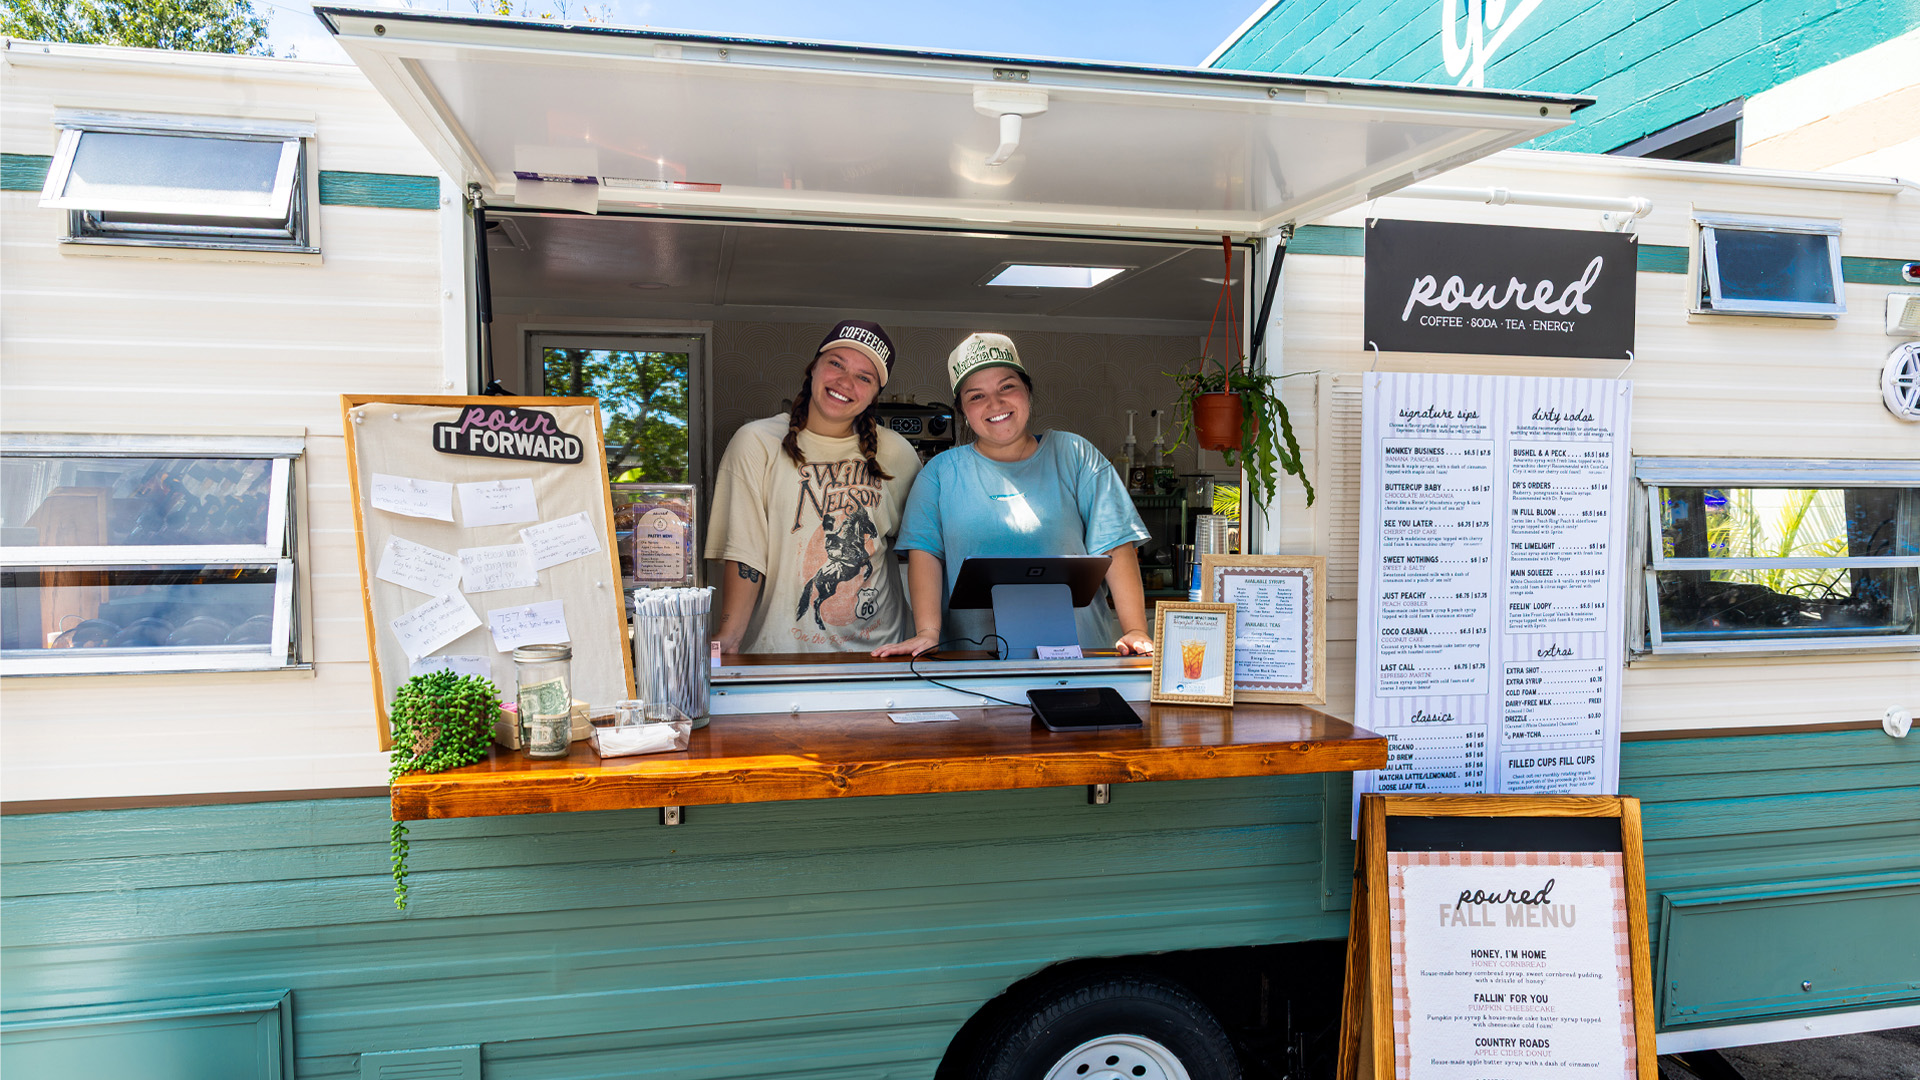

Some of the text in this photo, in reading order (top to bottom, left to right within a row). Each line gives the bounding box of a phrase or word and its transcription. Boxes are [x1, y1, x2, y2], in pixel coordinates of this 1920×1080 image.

[1402, 256, 1603, 321] poured
[1420, 316, 1575, 333] COFFEE SODA TEA ENERGY
[839, 326, 890, 365] COFFEEGRL
[952, 347, 1014, 378] Matcha Club
[460, 408, 556, 434] pour
[1399, 404, 1480, 422] signature sips
[1532, 408, 1594, 424] dirty sodas
[440, 426, 580, 460] IT FORWARD
[861, 601, 874, 616] 66
[812, 633, 826, 644] the
[1538, 643, 1574, 658] extras
[1411, 710, 1454, 723] classics
[1509, 755, 1595, 768] FILLED CUPS FILL CUPS
[1405, 772, 1456, 780] LATTE/LEMONADE
[1456, 878, 1555, 910] poured
[1440, 904, 1576, 928] FALL MENU
[1471, 950, 1546, 959] HONEY, I'M HOME
[1474, 994, 1548, 1003] FALLIN' FOR YOU
[1475, 1038, 1550, 1048] COUNTRY ROADS
